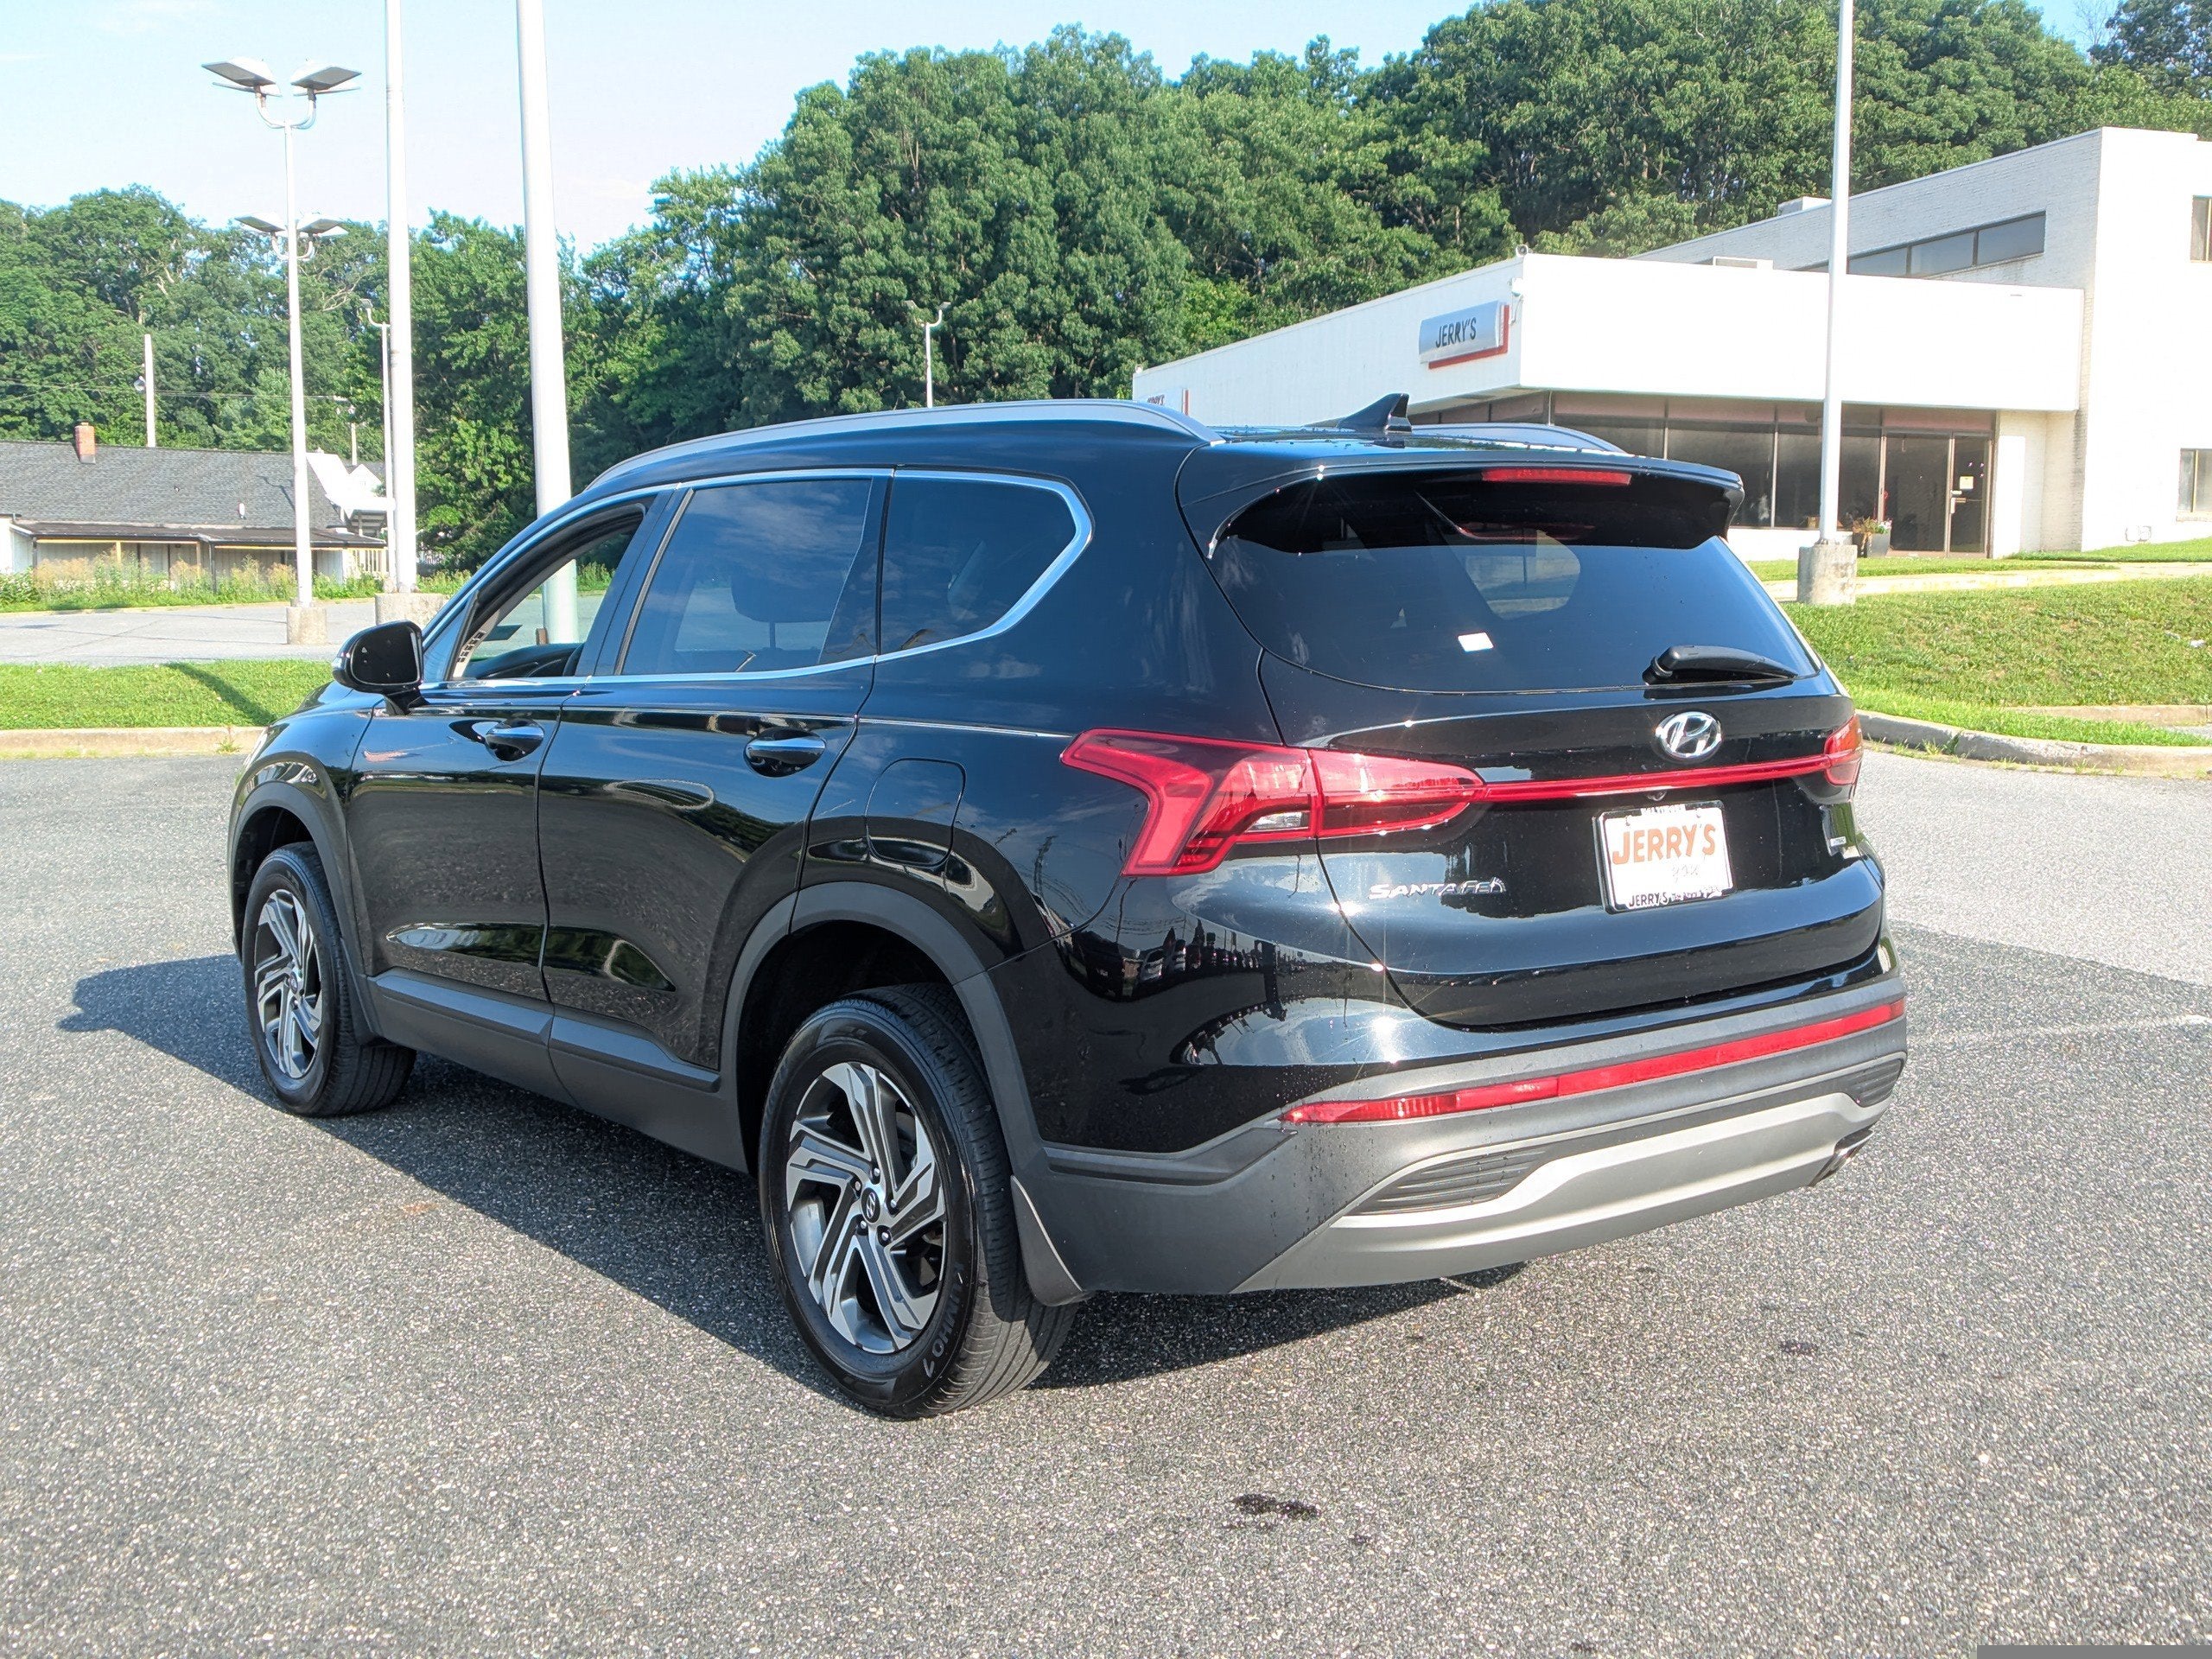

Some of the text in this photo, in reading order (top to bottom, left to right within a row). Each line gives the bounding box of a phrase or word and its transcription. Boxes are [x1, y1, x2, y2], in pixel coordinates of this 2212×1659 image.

[1435, 317, 1477, 347] JERRY'S
[1612, 823, 1716, 865] JERRY'S
[1368, 882, 1457, 900] SANTA
